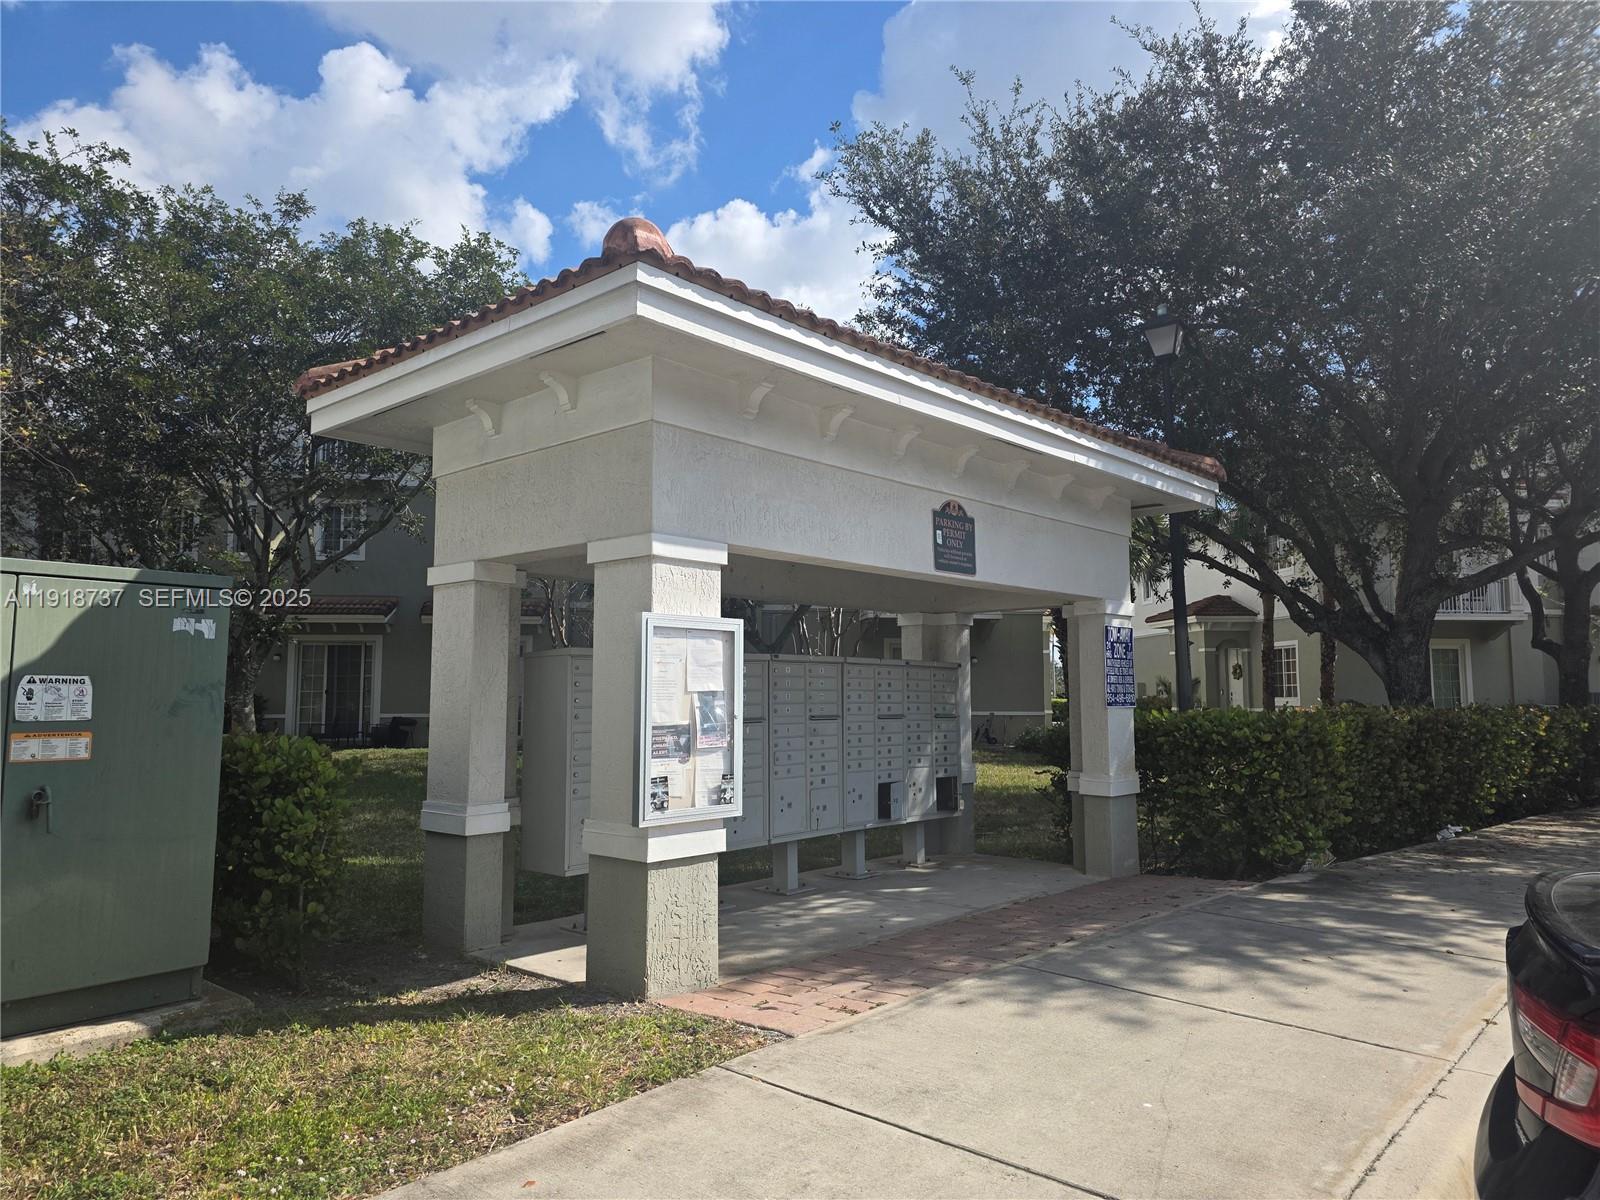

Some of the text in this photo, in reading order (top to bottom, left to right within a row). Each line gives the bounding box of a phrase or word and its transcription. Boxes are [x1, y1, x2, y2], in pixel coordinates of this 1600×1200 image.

[936, 517, 964, 530] PARKING
[943, 528, 966, 540] PERMIT
[946, 538, 964, 548] ONLY
[1114, 642, 1126, 658] ZONE
[38, 677, 86, 685] WARNING
